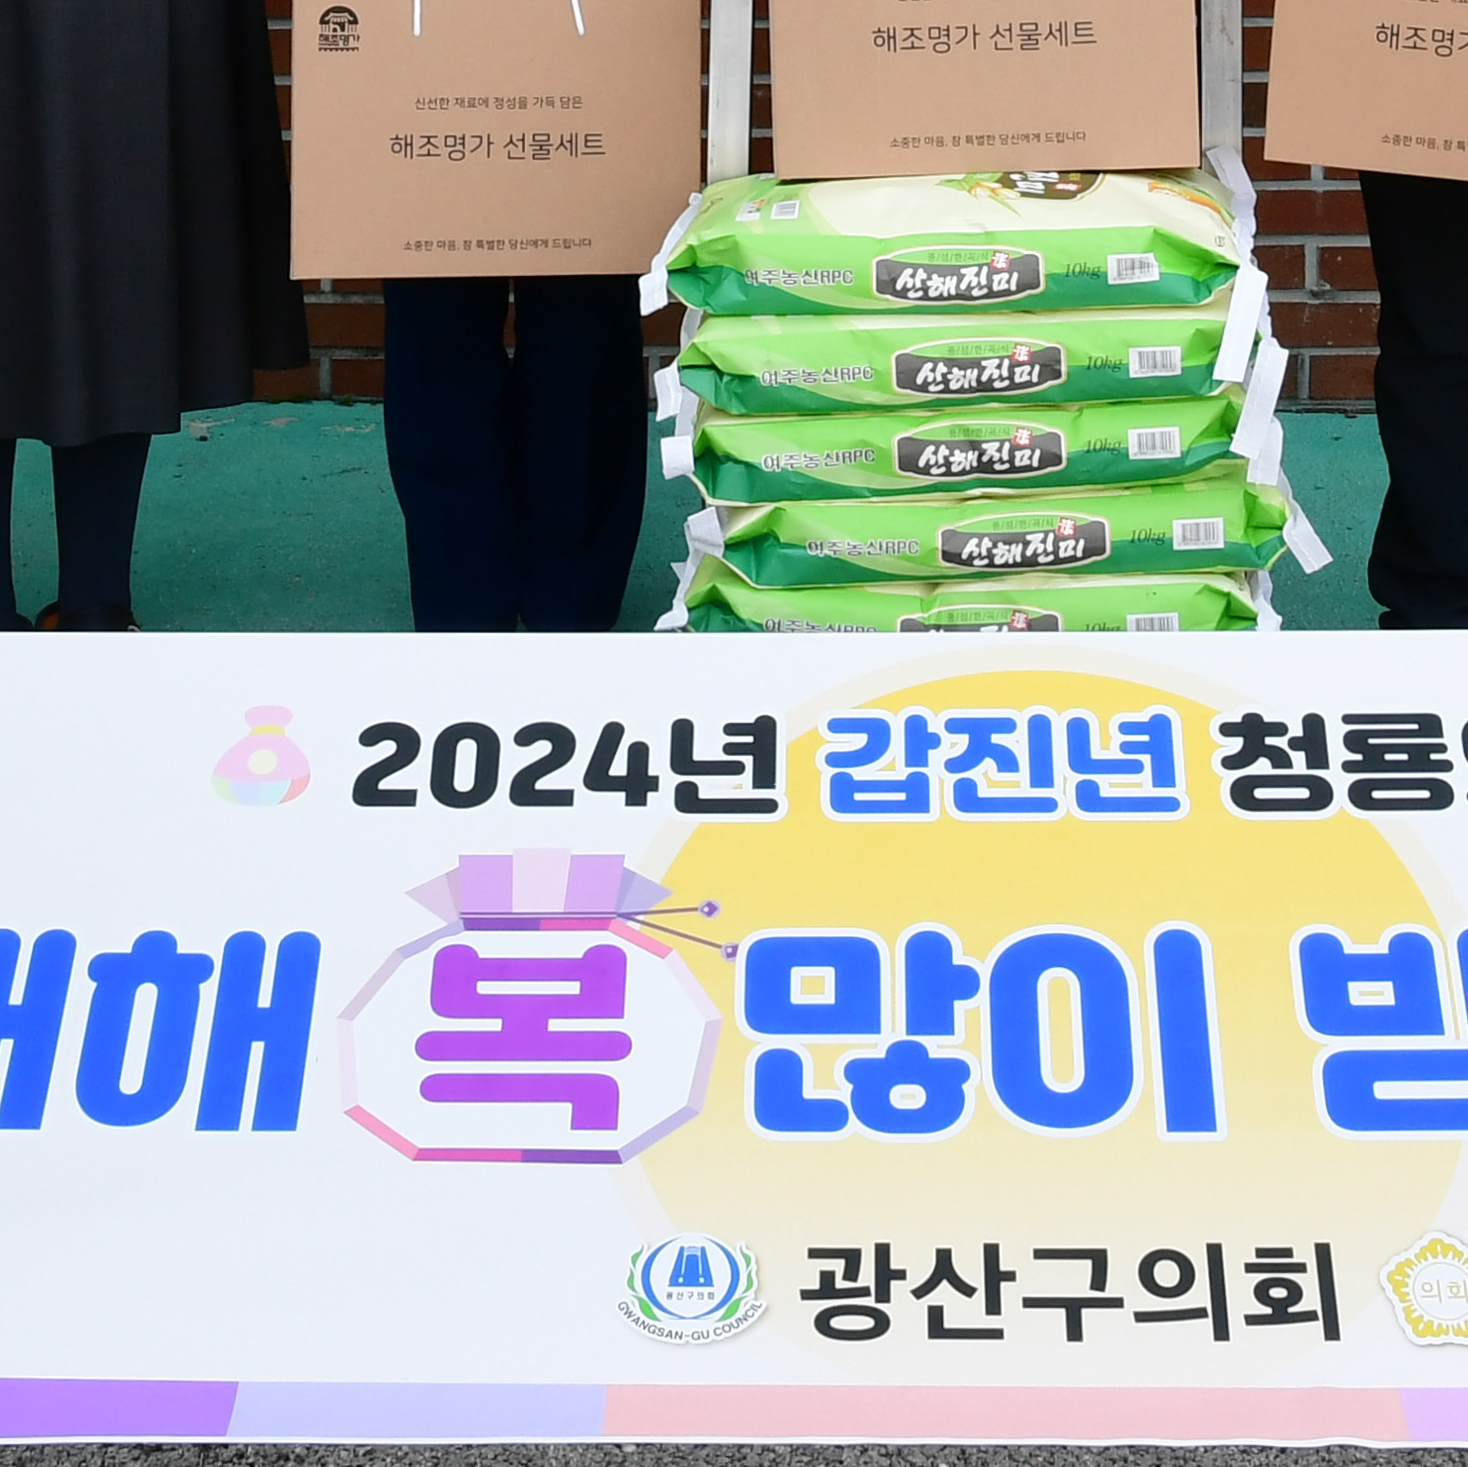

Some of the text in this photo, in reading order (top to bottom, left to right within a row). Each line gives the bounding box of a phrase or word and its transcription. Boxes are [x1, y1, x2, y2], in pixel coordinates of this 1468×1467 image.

[871, 20, 1098, 54] 해조명가 선물세트
[414, 95, 583, 111] 신선한 재료에 정성을 가득 담은
[389, 132, 606, 162] 해조명가 선물세트
[890, 136, 922, 149] 소중한
[965, 134, 996, 147] 특별한
[998, 132, 1041, 146] 당신에게
[1044, 131, 1087, 144] 드립니다
[1381, 133, 1413, 148] 소중한
[403, 240, 434, 252] 소중한
[475, 239, 506, 251] 특별한
[508, 238, 549, 251] 당신에게
[551, 237, 592, 250] 드립니다
[895, 265, 1019, 299] 산해진미
[1063, 262, 1102, 281] 10kg
[916, 354, 1041, 390] 산해진미
[1084, 353, 1124, 373] 10kg
[918, 440, 1042, 475] 산해진미
[1083, 436, 1124, 457] 10kg
[961, 529, 1085, 566] 산해진미
[1129, 527, 1167, 545] 10kg
[352, 714, 779, 814] 2024년
[824, 712, 1181, 814] 갑진년
[417, 945, 623, 1131] 복
[744, 929, 1217, 1134] 많이
[665, 1291, 715, 1301] 광산구의회
[800, 1242, 1341, 1342] 광산구의회
[617, 1301, 764, 1341] GWANGSAN-GU COUNCIL
